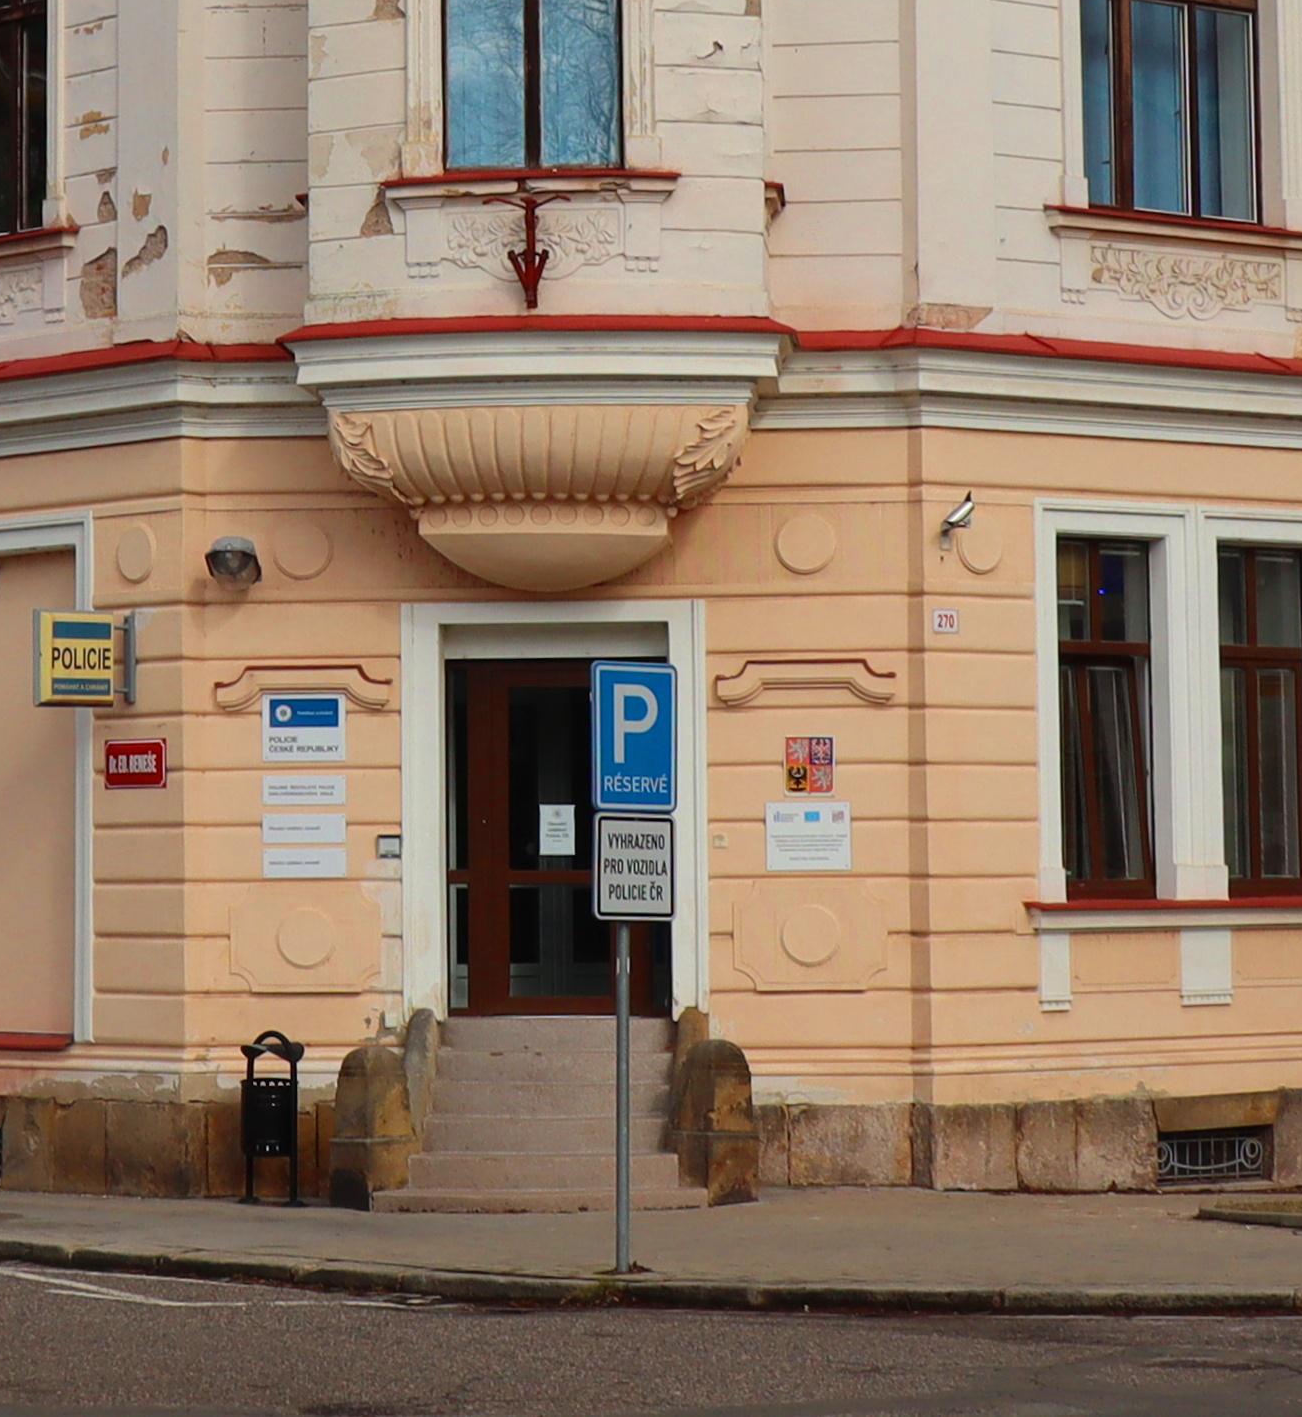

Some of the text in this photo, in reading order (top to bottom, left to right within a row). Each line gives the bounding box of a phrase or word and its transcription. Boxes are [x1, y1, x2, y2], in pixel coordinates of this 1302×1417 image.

[937, 614, 955, 629] 270
[51, 647, 112, 670] POLICIE
[613, 683, 659, 763] P
[268, 735, 298, 743] POLICIE
[268, 744, 339, 753] ČESKÉ REPUBLIKY
[129, 751, 157, 774] BENEŠE
[604, 772, 668, 793] RÉSERVÉ
[607, 833, 666, 851] VYHRAZENO
[603, 859, 668, 876] PRO VOZIDLA
[608, 881, 664, 901] POLICIE ČR
